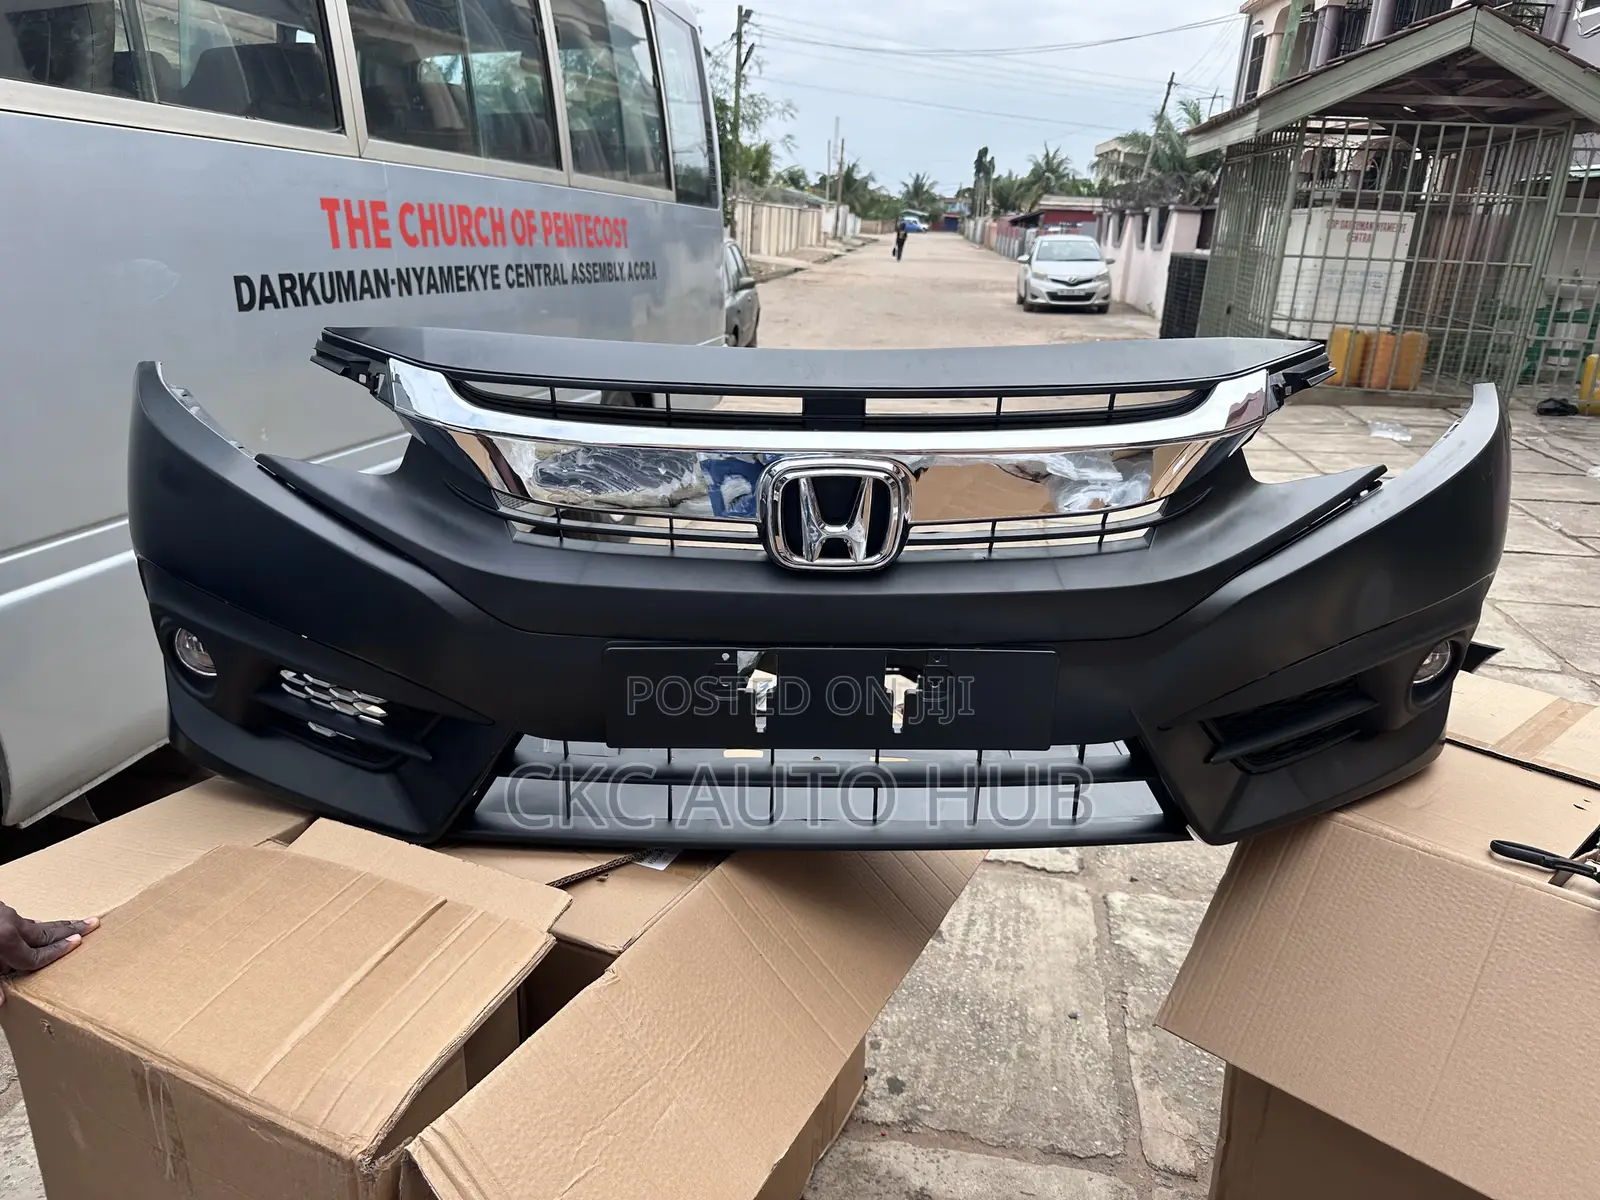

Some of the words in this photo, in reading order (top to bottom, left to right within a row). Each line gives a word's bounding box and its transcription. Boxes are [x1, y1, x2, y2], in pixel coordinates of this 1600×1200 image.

[320, 198, 392, 249] THE
[398, 202, 508, 248] CHURCH
[510, 208, 538, 248] OF
[540, 211, 629, 249] PENTECOST
[505, 263, 569, 289] CENTRAL
[627, 260, 658, 281] ACCRA
